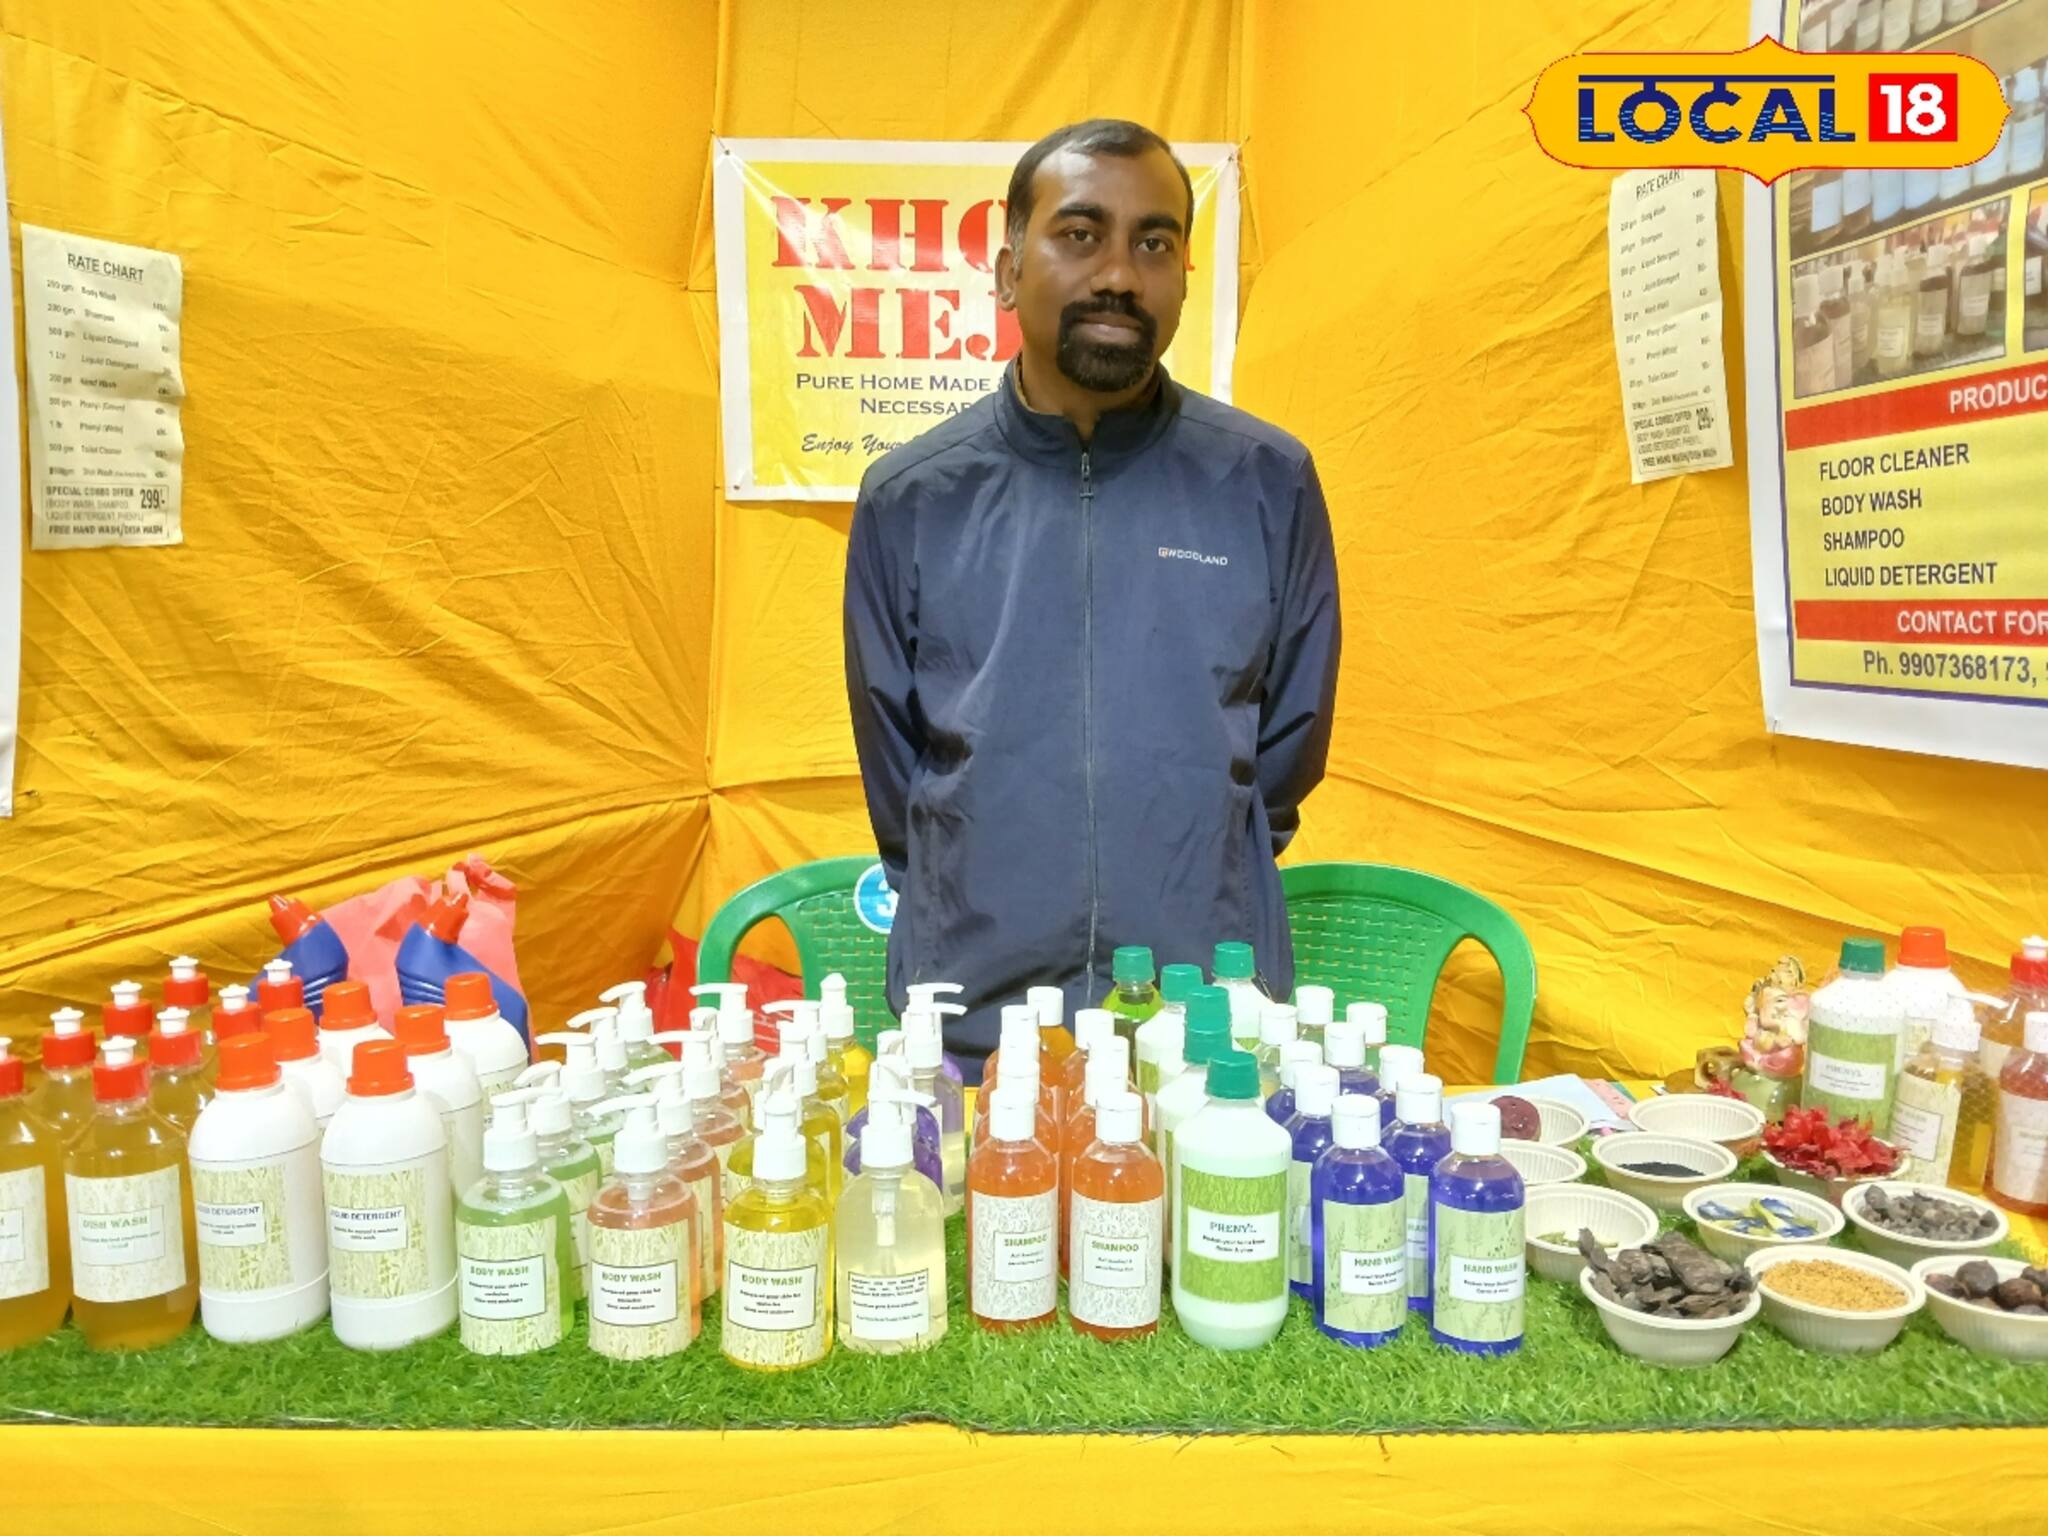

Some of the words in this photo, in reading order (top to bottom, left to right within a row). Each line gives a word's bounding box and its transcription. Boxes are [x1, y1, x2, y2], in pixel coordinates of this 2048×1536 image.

[67, 253, 100, 273] RATE
[103, 261, 145, 282] CHART
[793, 284, 1023, 362] MEJ
[796, 373, 854, 390] PURE
[860, 374, 923, 391] HOME
[929, 374, 992, 392] MADE
[1949, 373, 2048, 415] PRODUC
[860, 398, 973, 415] NECESSA
[802, 433, 854, 456] Enjoy
[862, 433, 904, 456] You
[1820, 456, 1875, 482] FLOOR
[1880, 443, 1970, 474] CLEANER
[1821, 492, 1867, 517] BODY
[1869, 487, 1923, 513] WASH
[1823, 527, 1905, 552] SHAMPOO
[1825, 566, 1875, 587] LIQUID
[1880, 562, 1998, 586] DETERGENT
[1897, 610, 1998, 634] CONTACT
[1863, 650, 1893, 675] Ph.
[1899, 652, 2038, 688] 9907368173,
[110, 1215, 148, 1229] WASH
[1092, 1240, 1140, 1253] SHAMPOO
[470, 1265, 494, 1277] BODY
[497, 1265, 530, 1277] WASH
[1354, 1258, 1382, 1268] HAND
[1463, 1263, 1492, 1274] HAND
[602, 1271, 627, 1283] BODY
[629, 1271, 662, 1283] WASH
[741, 1273, 768, 1286] BODY
[770, 1275, 802, 1287] WASH
